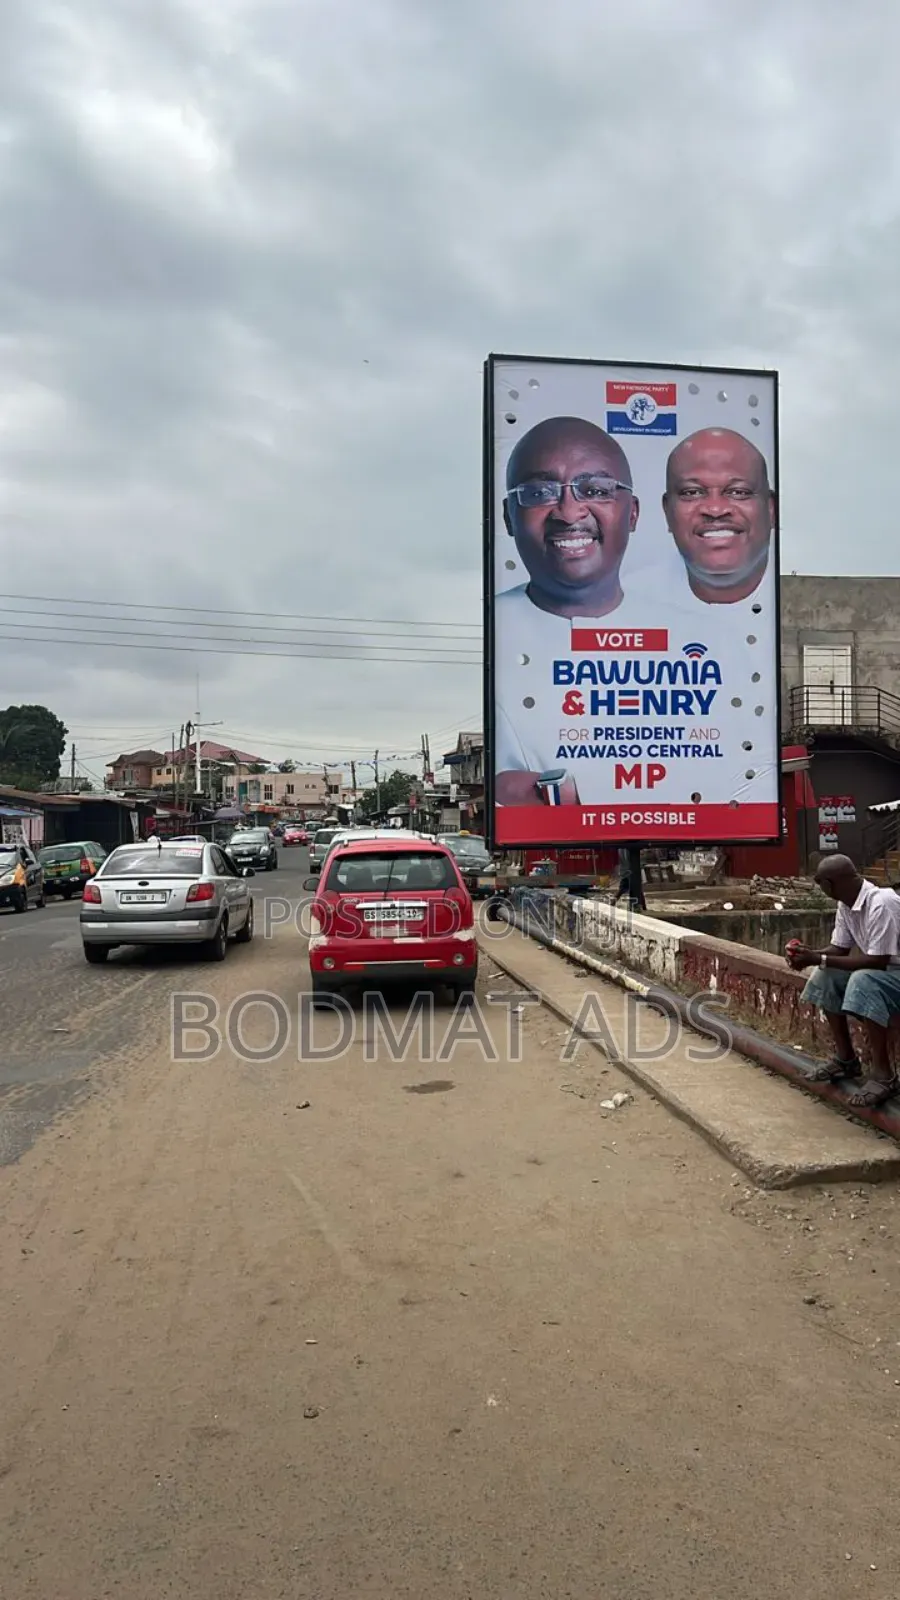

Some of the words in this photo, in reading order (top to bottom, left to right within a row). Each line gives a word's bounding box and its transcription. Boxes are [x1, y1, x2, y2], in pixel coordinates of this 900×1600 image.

[596, 633, 644, 647] VOTE
[553, 660, 722, 686] BAWUMIA
[558, 728, 590, 741] FOR
[594, 727, 685, 740] PRESIDENT
[688, 728, 720, 740] AND
[556, 744, 642, 758] AYAWASO
[647, 744, 723, 758] CENTRAL
[614, 764, 666, 790] MP
[582, 813, 596, 825] IT
[601, 812, 616, 825] IS
[621, 812, 696, 825] POSSIBLE
